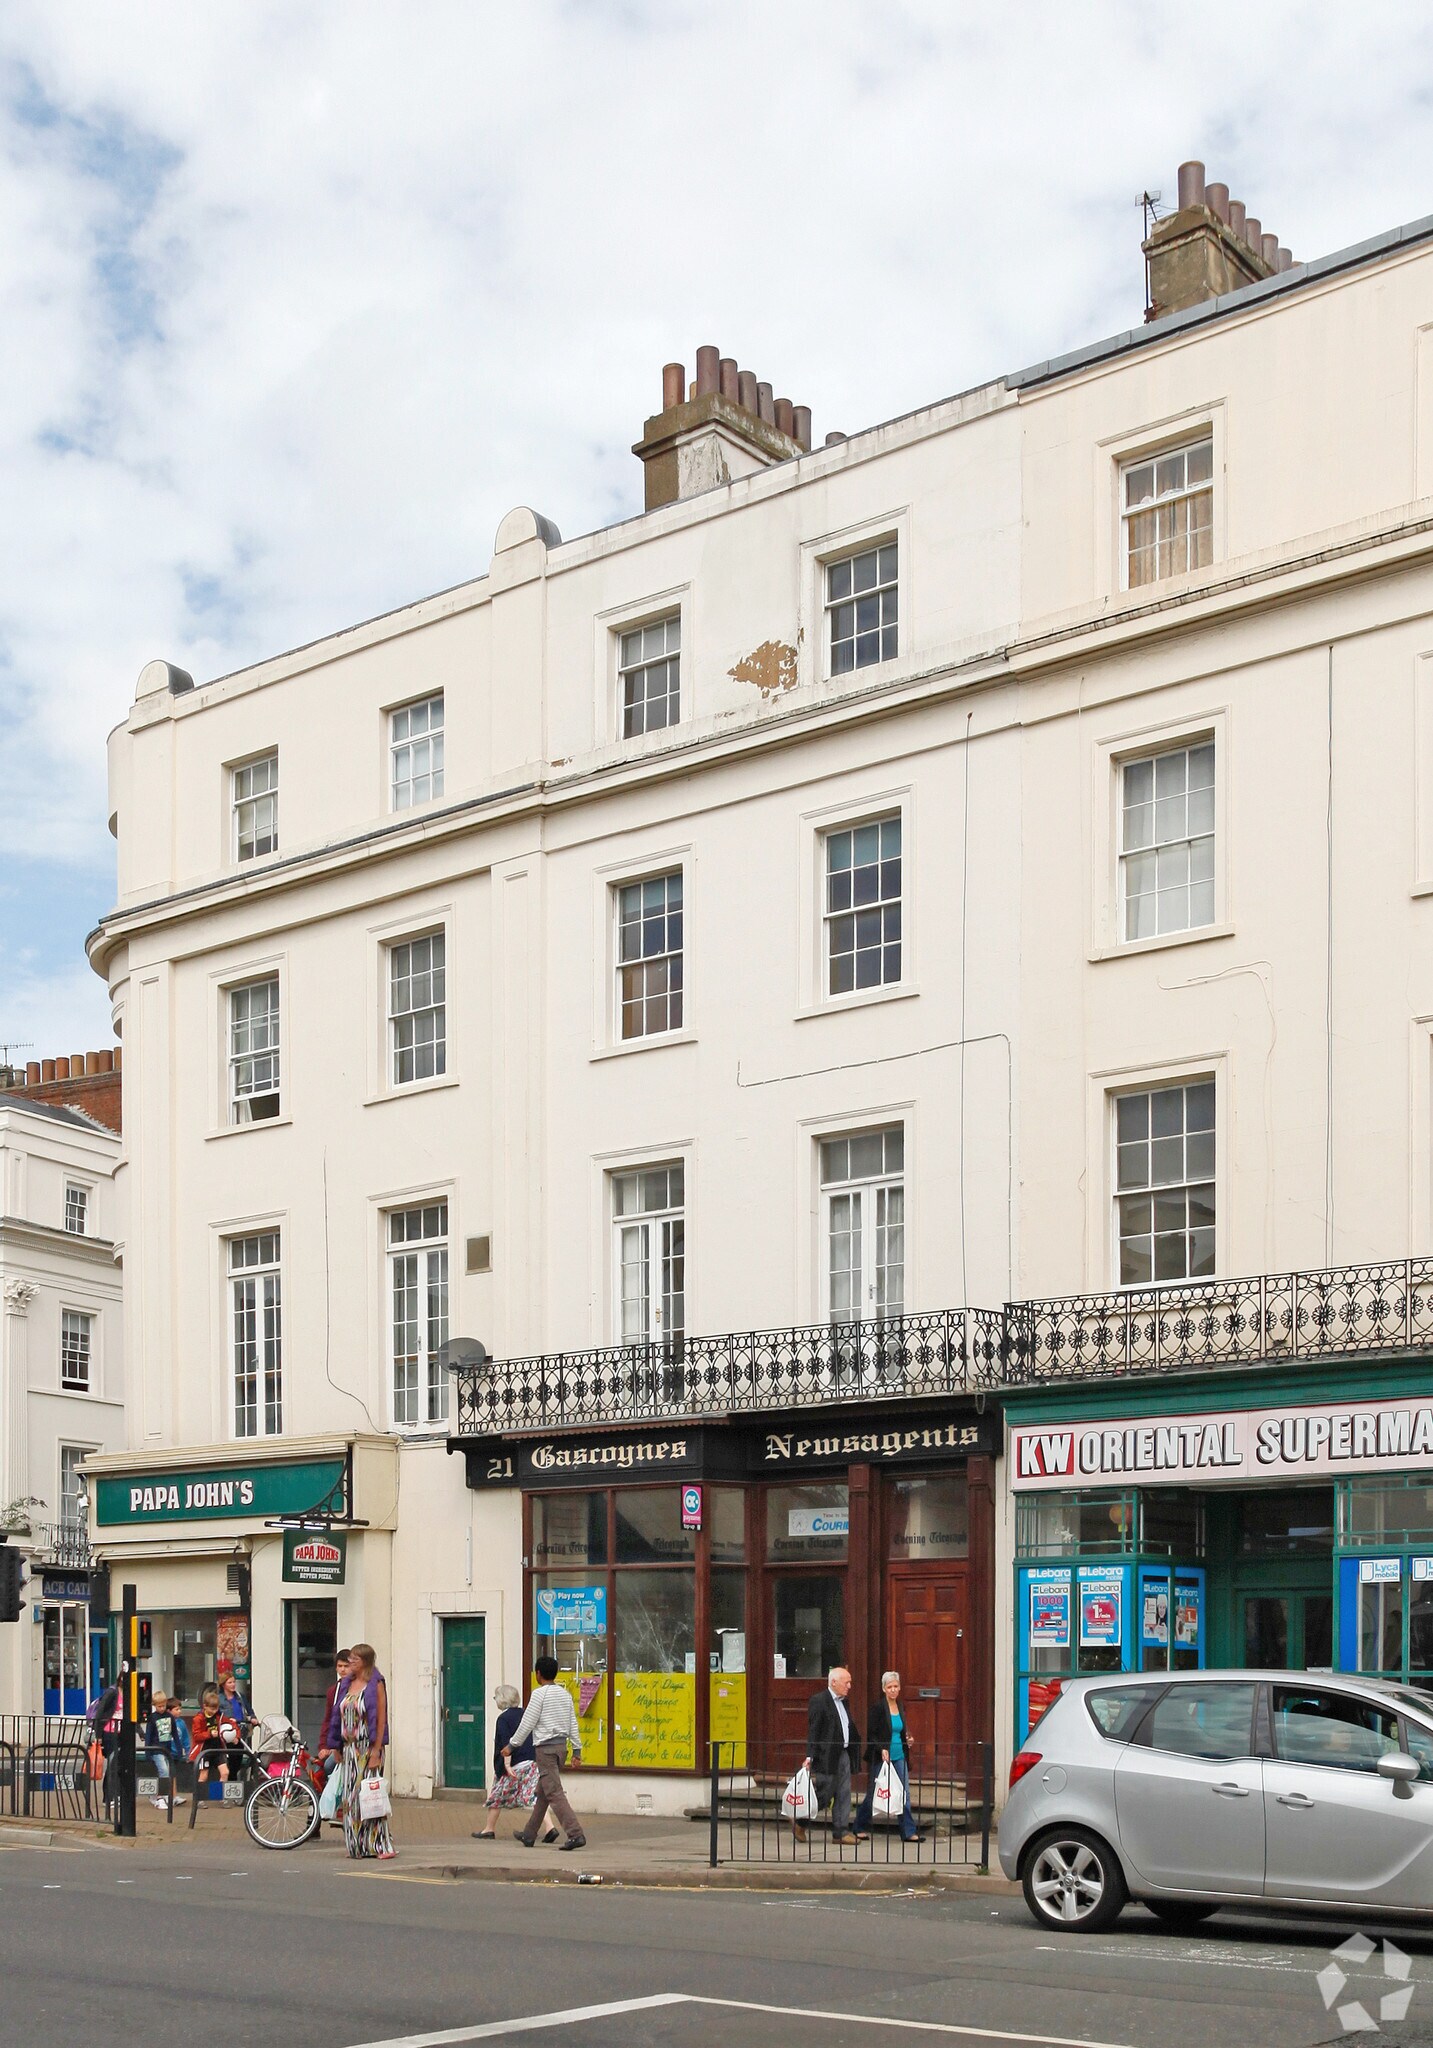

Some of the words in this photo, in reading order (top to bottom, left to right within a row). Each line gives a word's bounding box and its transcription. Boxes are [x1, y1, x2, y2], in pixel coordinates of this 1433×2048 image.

[764, 1423, 979, 1460] Newsagents
[1020, 1435, 1073, 1476] KW
[1079, 1422, 1243, 1473] ORIENTAL
[1256, 1408, 1433, 1464] SUPERMA
[530, 1440, 687, 1469] Gascoynes
[486, 1457, 514, 1479] 21
[130, 1485, 180, 1512] PAPA
[185, 1480, 254, 1509] JOHN'S
[295, 1545, 314, 1560] PAPA
[1036, 1568, 1071, 1578] Lebara
[1087, 1566, 1123, 1576] Lebara
[1375, 1563, 1398, 1571] Lyca
[43, 1581, 65, 1595] ACE
[1040, 1586, 1069, 1594] Lebara
[1090, 1584, 1119, 1592] Lebara
[557, 1592, 571, 1600] Play
[1038, 1595, 1064, 1606] 1000
[626, 1678, 647, 1692] Open
[661, 1678, 686, 1692] Days
[633, 1695, 679, 1709] Magazines
[640, 1713, 673, 1725] Stamps
[659, 1730, 667, 1741] &
[620, 1747, 635, 1762] Gift
[638, 1748, 657, 1761] Wrap
[660, 1748, 668, 1760] &
